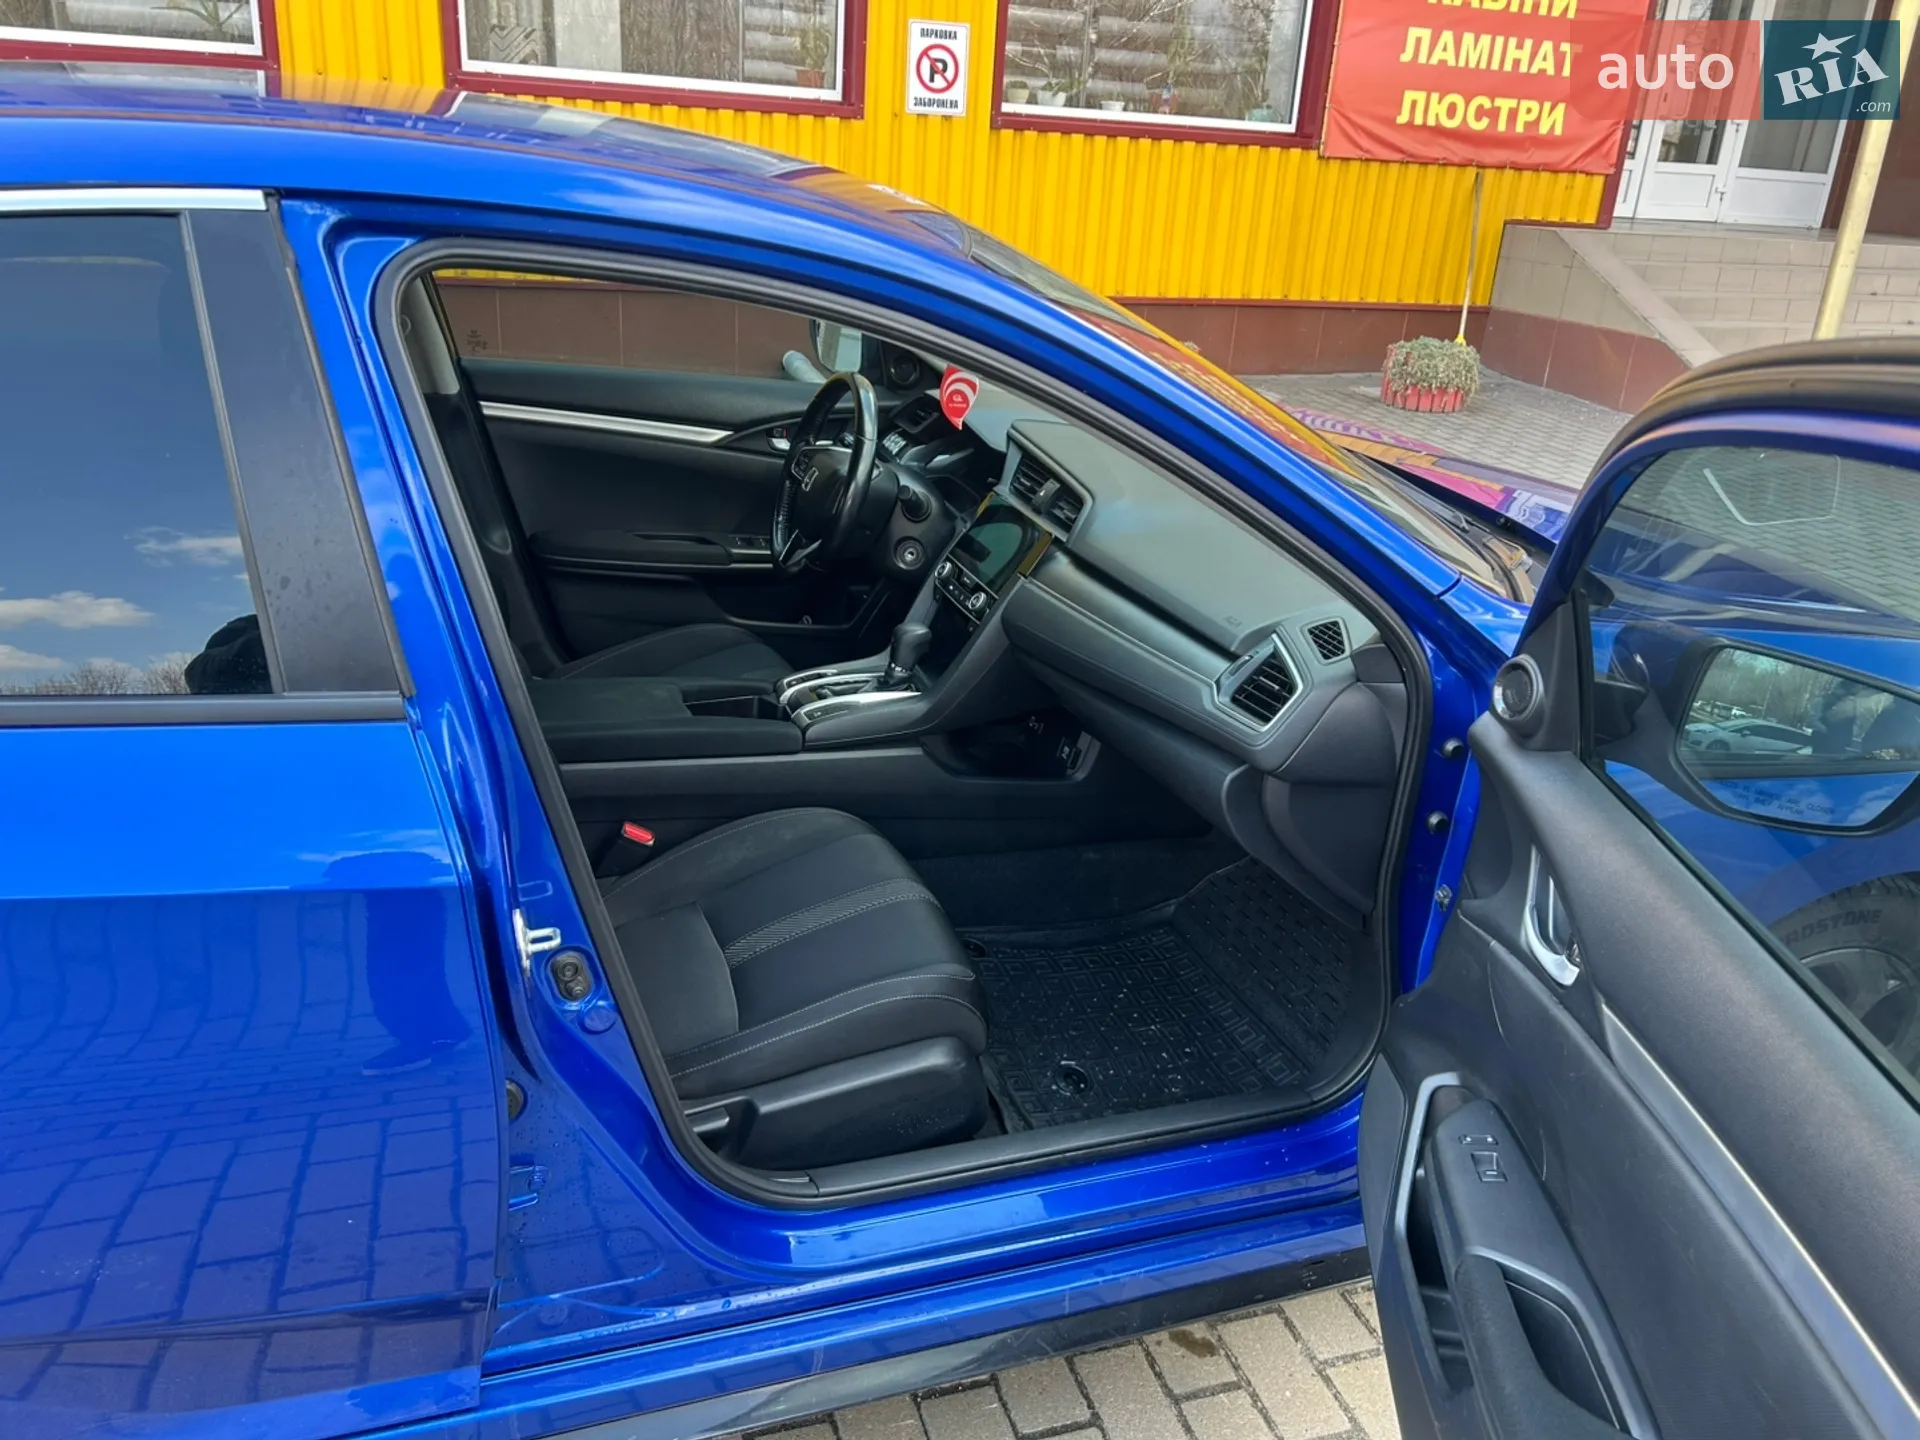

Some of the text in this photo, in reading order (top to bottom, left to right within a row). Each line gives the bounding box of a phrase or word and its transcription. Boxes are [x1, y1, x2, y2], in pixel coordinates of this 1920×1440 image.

[920, 27, 957, 40] ПАРКОВКА
[1400, 26, 1583, 77] ЛАМІНАТ
[913, 96, 958, 110] ЗАБОРОНЕНА
[1396, 89, 1566, 136] ЛЮСТРИ
